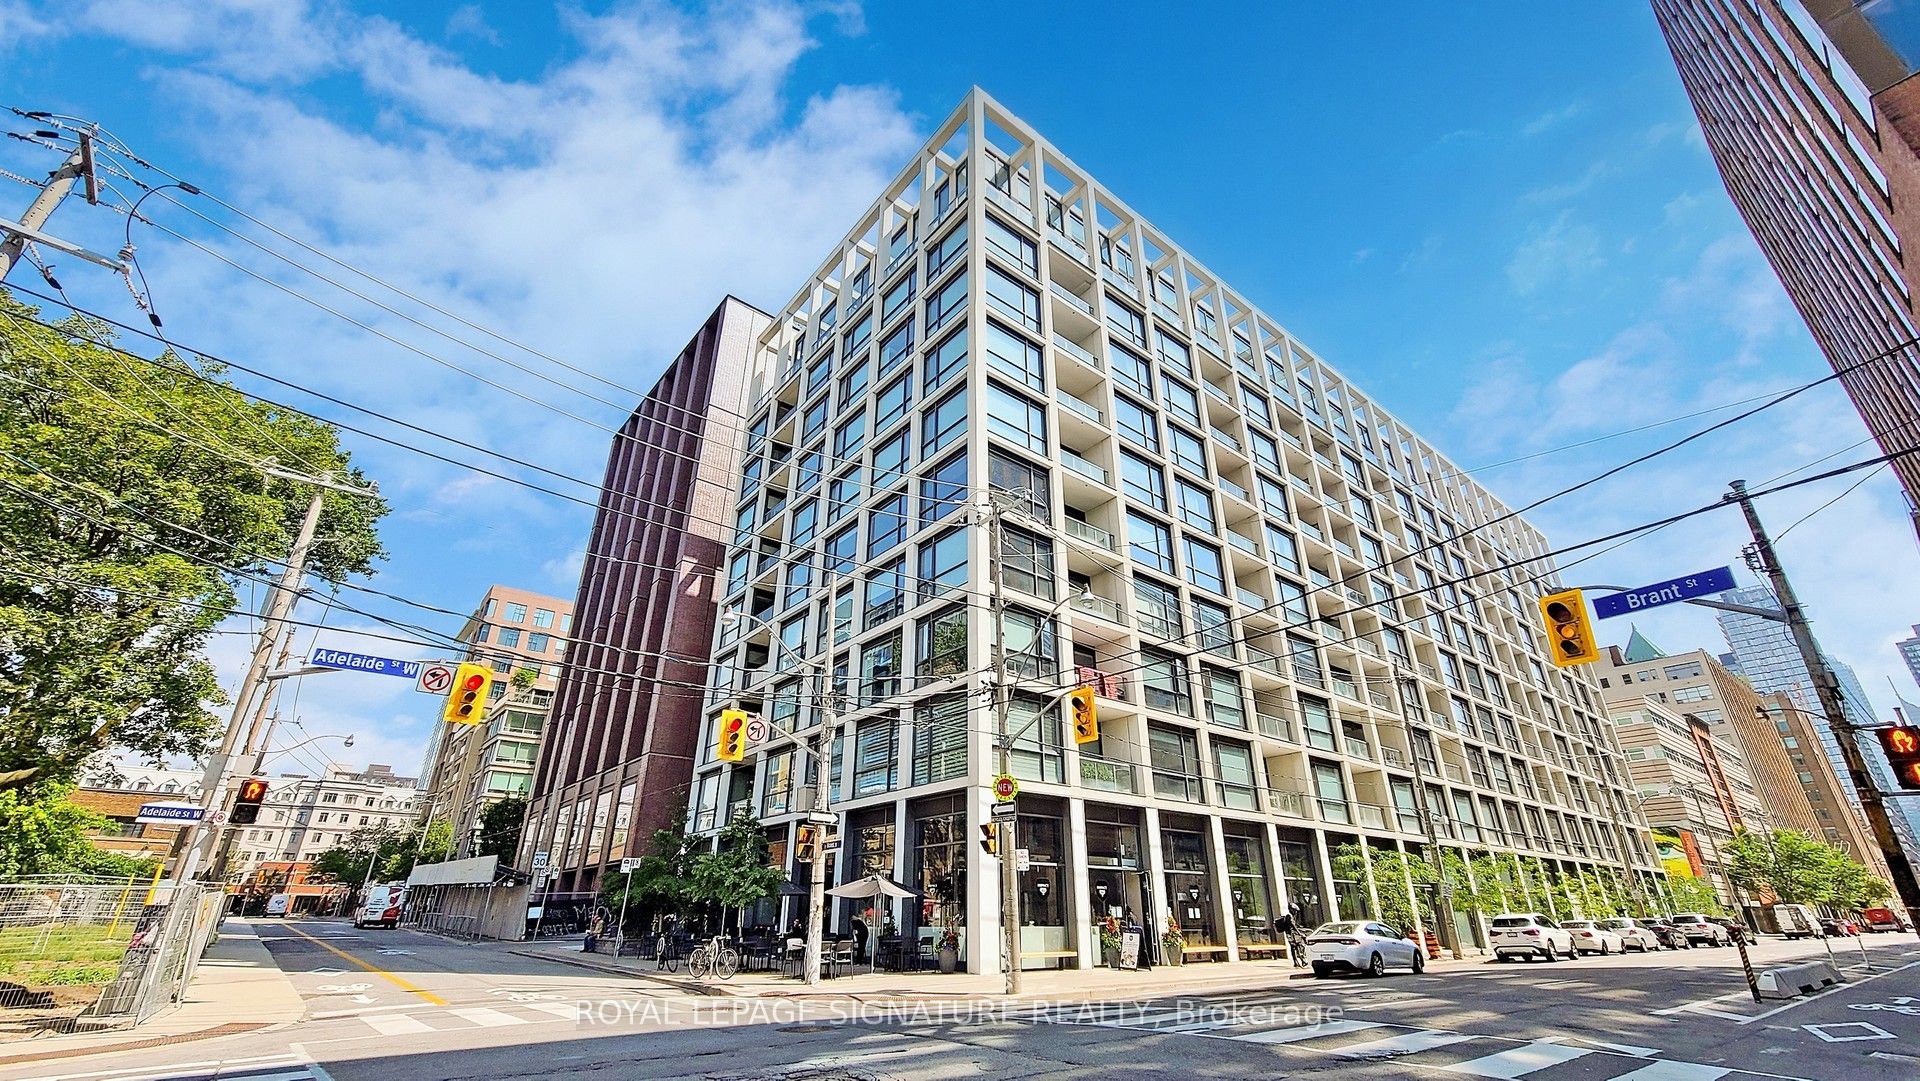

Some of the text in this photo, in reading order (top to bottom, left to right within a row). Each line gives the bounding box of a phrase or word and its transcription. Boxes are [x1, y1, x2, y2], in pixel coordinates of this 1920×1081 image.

[1626, 578, 1698, 609] Brant St
[314, 650, 418, 676] Adelaide St W
[998, 783, 1012, 792] NEW
[140, 807, 181, 817] Adelaide
[193, 810, 202, 819] W
[533, 857, 546, 867] 30
